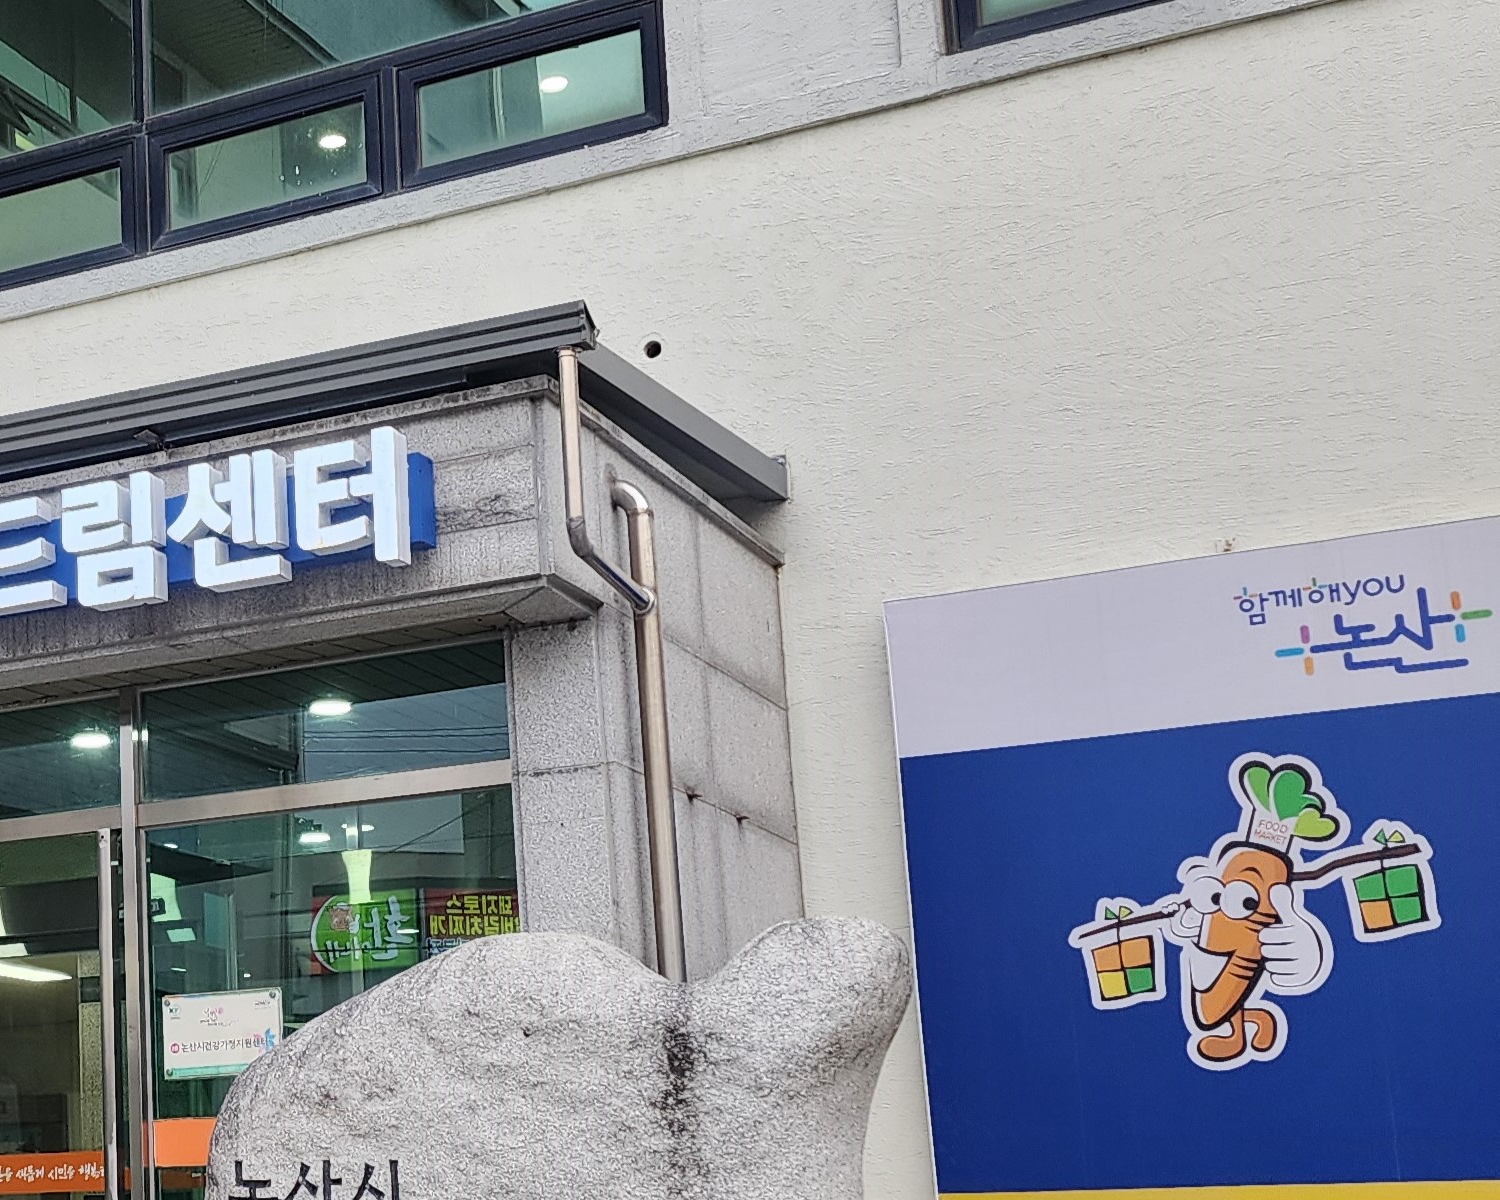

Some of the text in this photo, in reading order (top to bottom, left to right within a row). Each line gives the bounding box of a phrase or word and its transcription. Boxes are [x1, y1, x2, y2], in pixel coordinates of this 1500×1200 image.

[1310, 587, 1468, 673] 논산
[1258, 820, 1288, 834] FOOD
[1254, 829, 1287, 845] MARKET
[16, 1165, 45, 1182] 새롭게
[48, 1163, 76, 1181] 시민을
[77, 1161, 105, 1181] 행복
